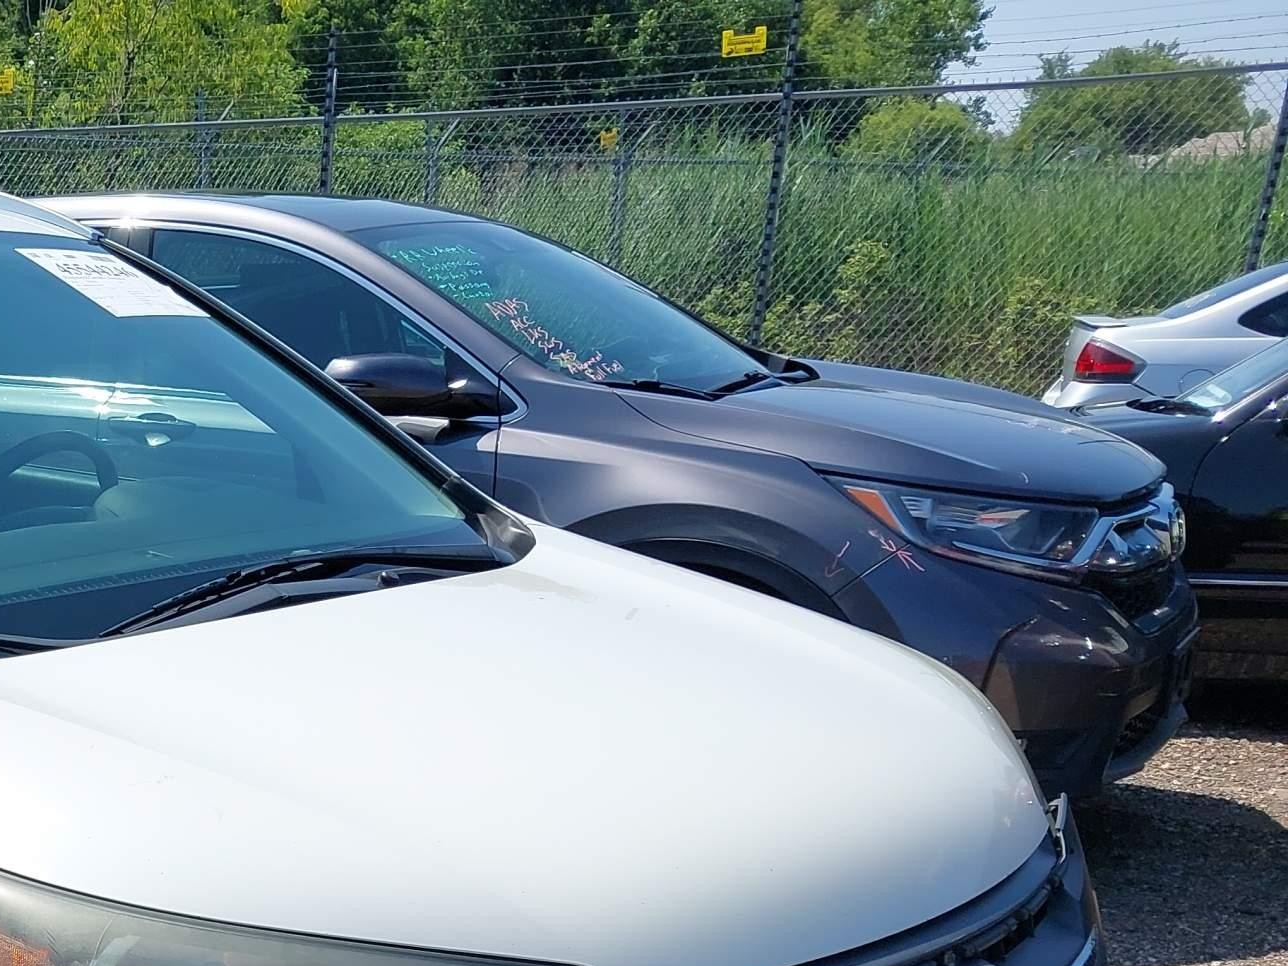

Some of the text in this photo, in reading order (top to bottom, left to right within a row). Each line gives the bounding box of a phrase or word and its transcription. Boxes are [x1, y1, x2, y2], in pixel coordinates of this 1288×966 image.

[55, 263, 139, 278] 45544246
[484, 297, 529, 321] ADAS
[510, 315, 536, 331] ACC
